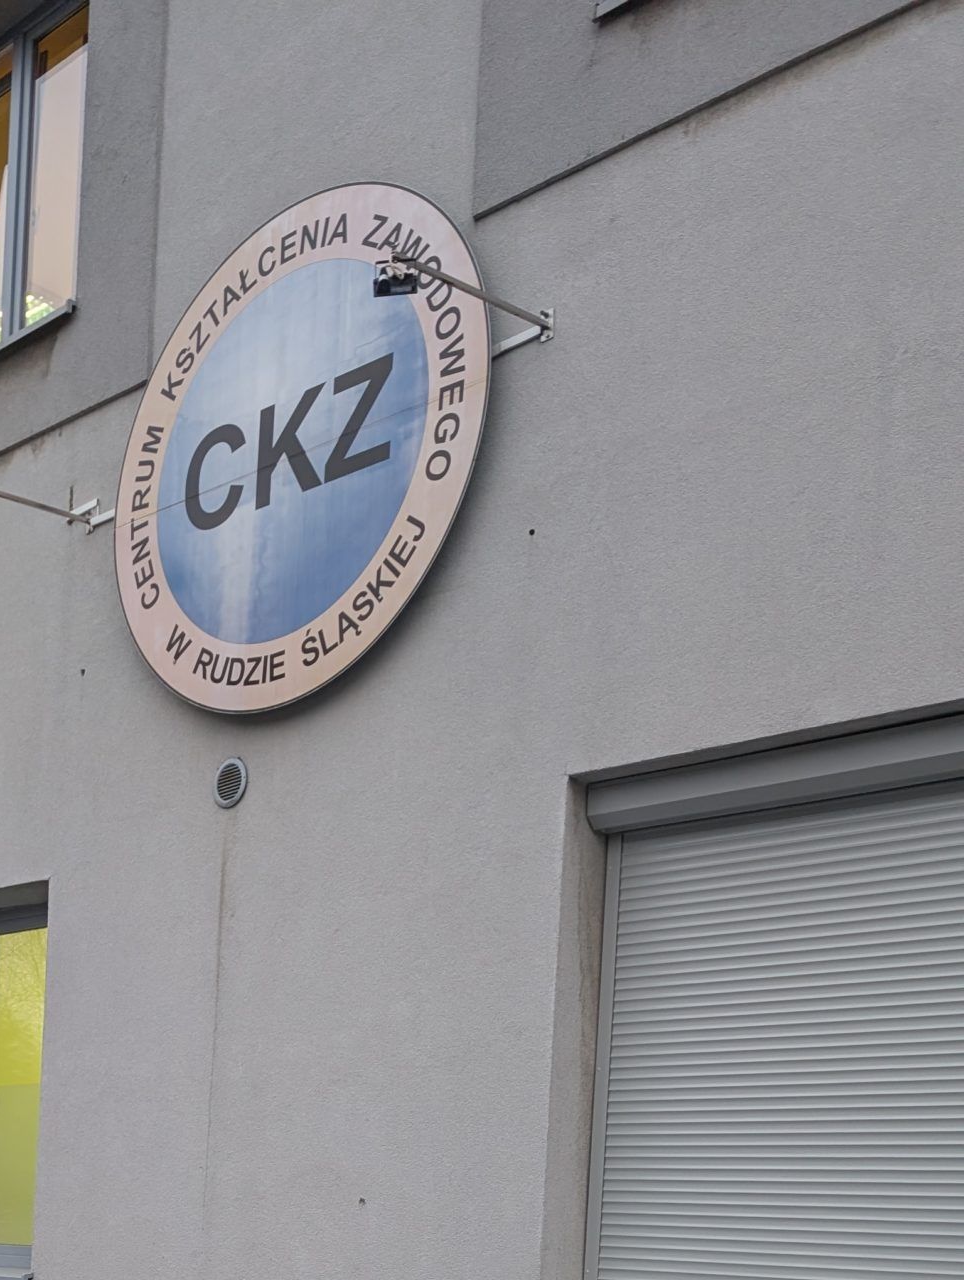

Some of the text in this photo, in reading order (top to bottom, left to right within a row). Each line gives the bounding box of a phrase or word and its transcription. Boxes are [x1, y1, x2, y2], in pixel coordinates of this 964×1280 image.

[132, 213, 467, 609] CENTRUM KSZTAŁCENIA ZAWODOWEGO
[184, 352, 395, 531] CKZ
[167, 514, 427, 687] W RUDZIE ŚLĄSKIEJ
